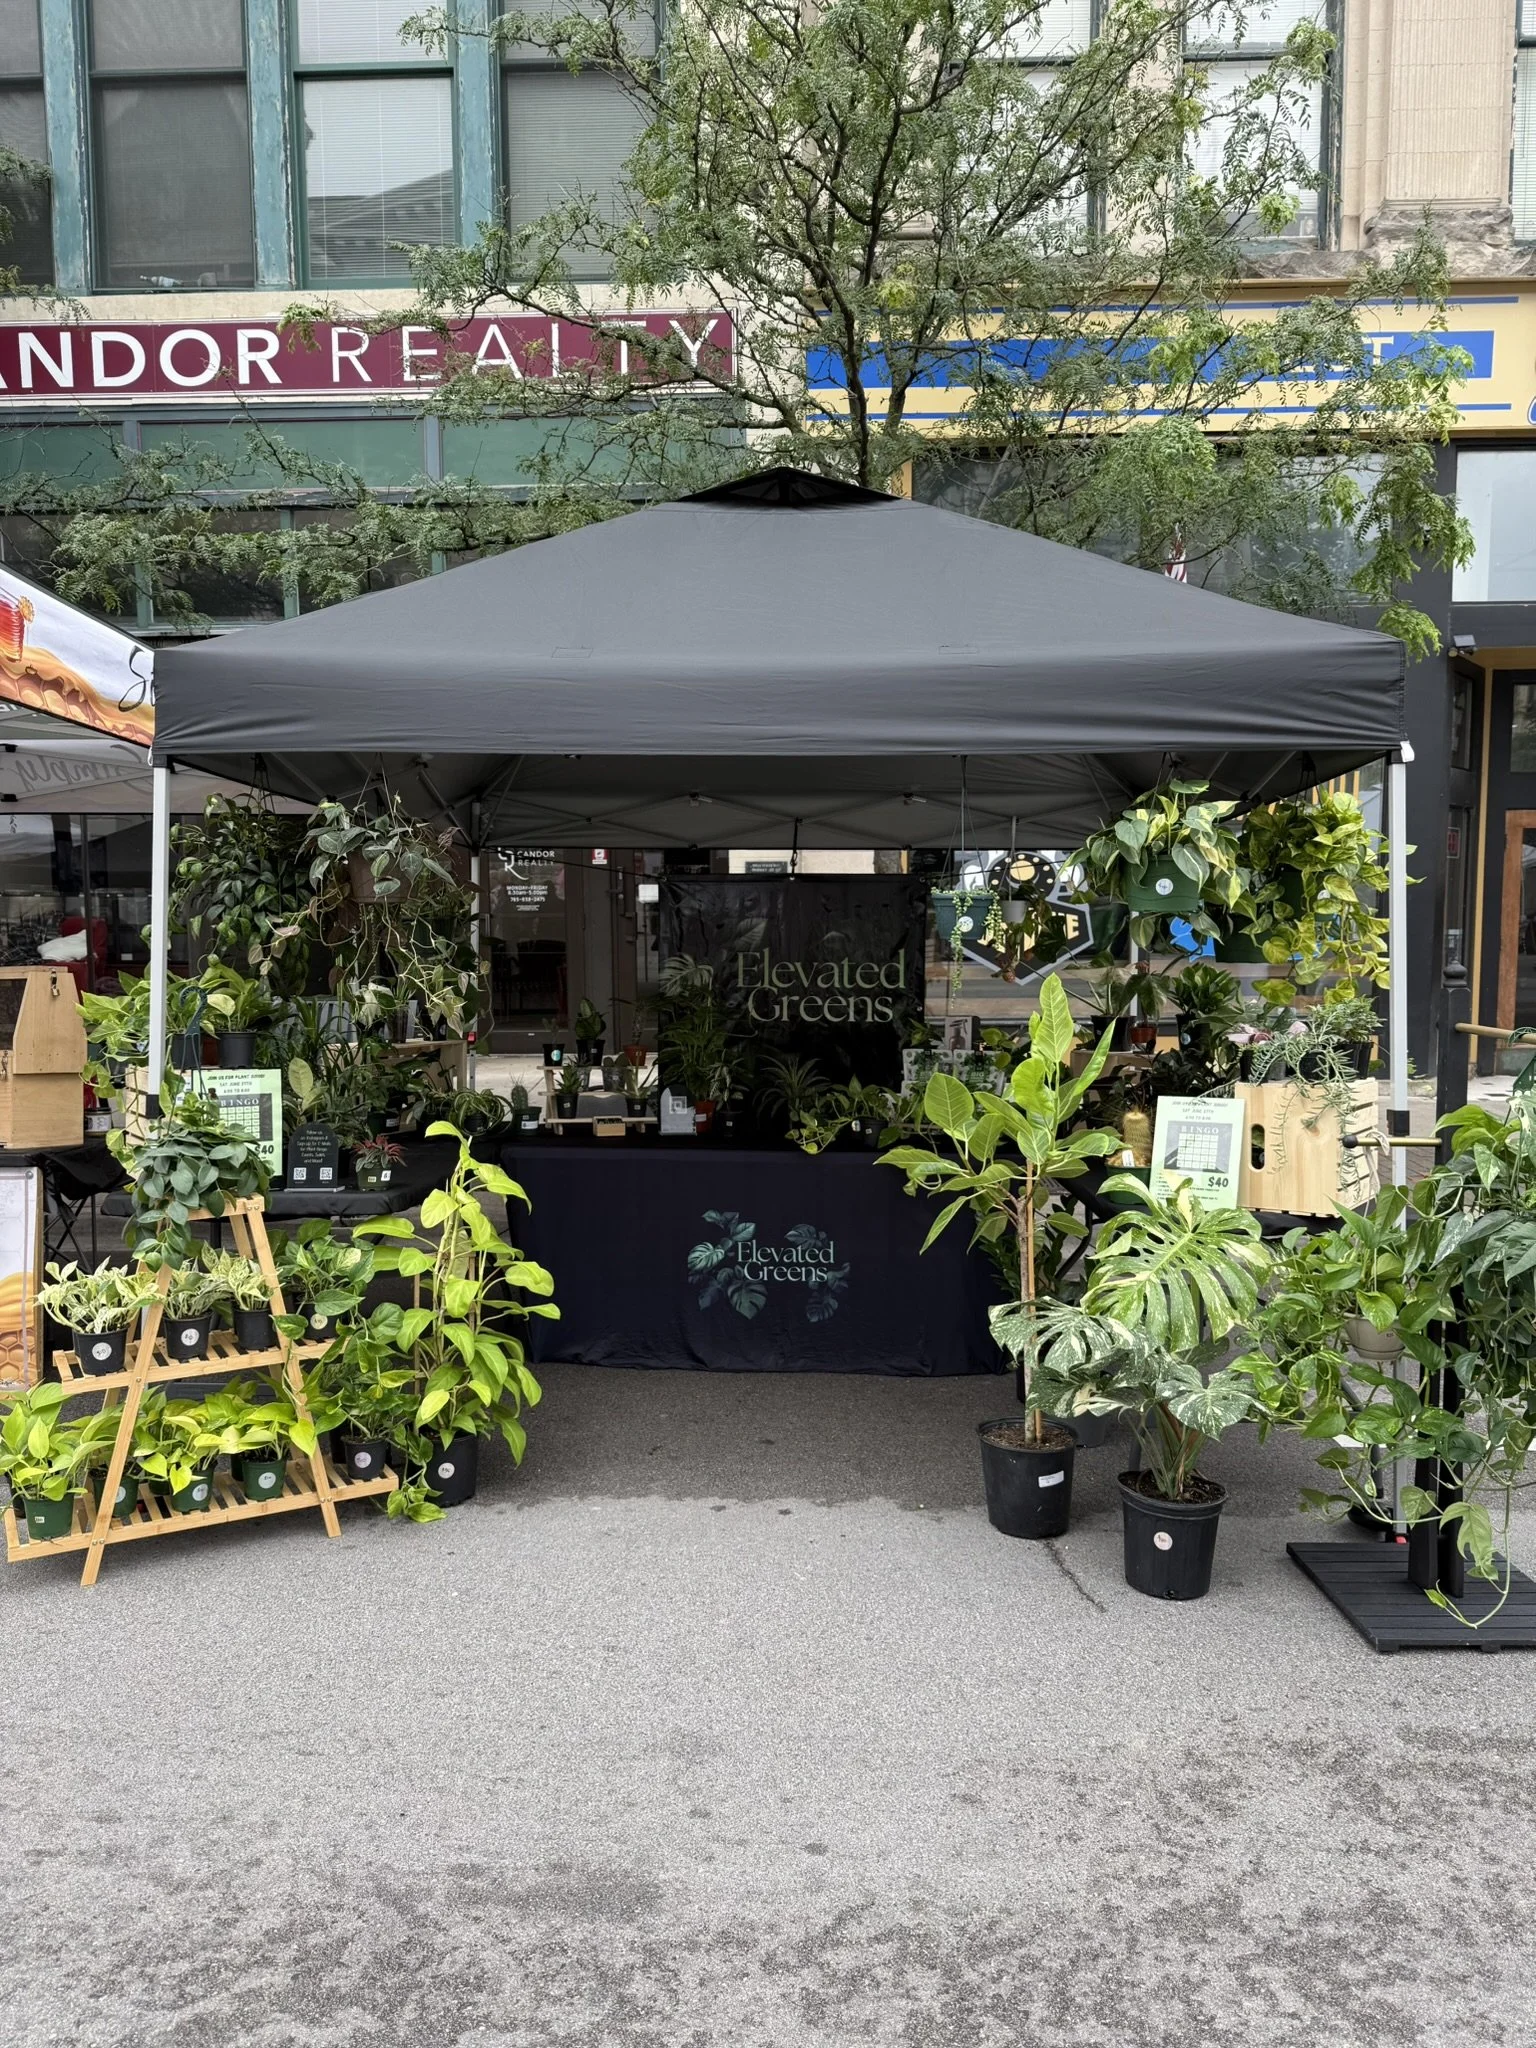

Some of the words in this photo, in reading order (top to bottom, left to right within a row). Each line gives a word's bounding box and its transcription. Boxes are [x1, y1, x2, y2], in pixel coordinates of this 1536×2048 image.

[0, 329, 282, 389] NDOR
[331, 319, 718, 383] REALTY
[517, 850, 555, 858] CANDOR
[737, 948, 906, 989] Elevated
[748, 985, 894, 1022] Greens
[220, 1098, 259, 1106] BINGO
[1181, 1125, 1219, 1134] BINGO
[254, 1145, 274, 1155] $40
[1208, 1176, 1229, 1188] $40
[737, 1239, 835, 1264] Elevated
[744, 1261, 828, 1282] Greens
